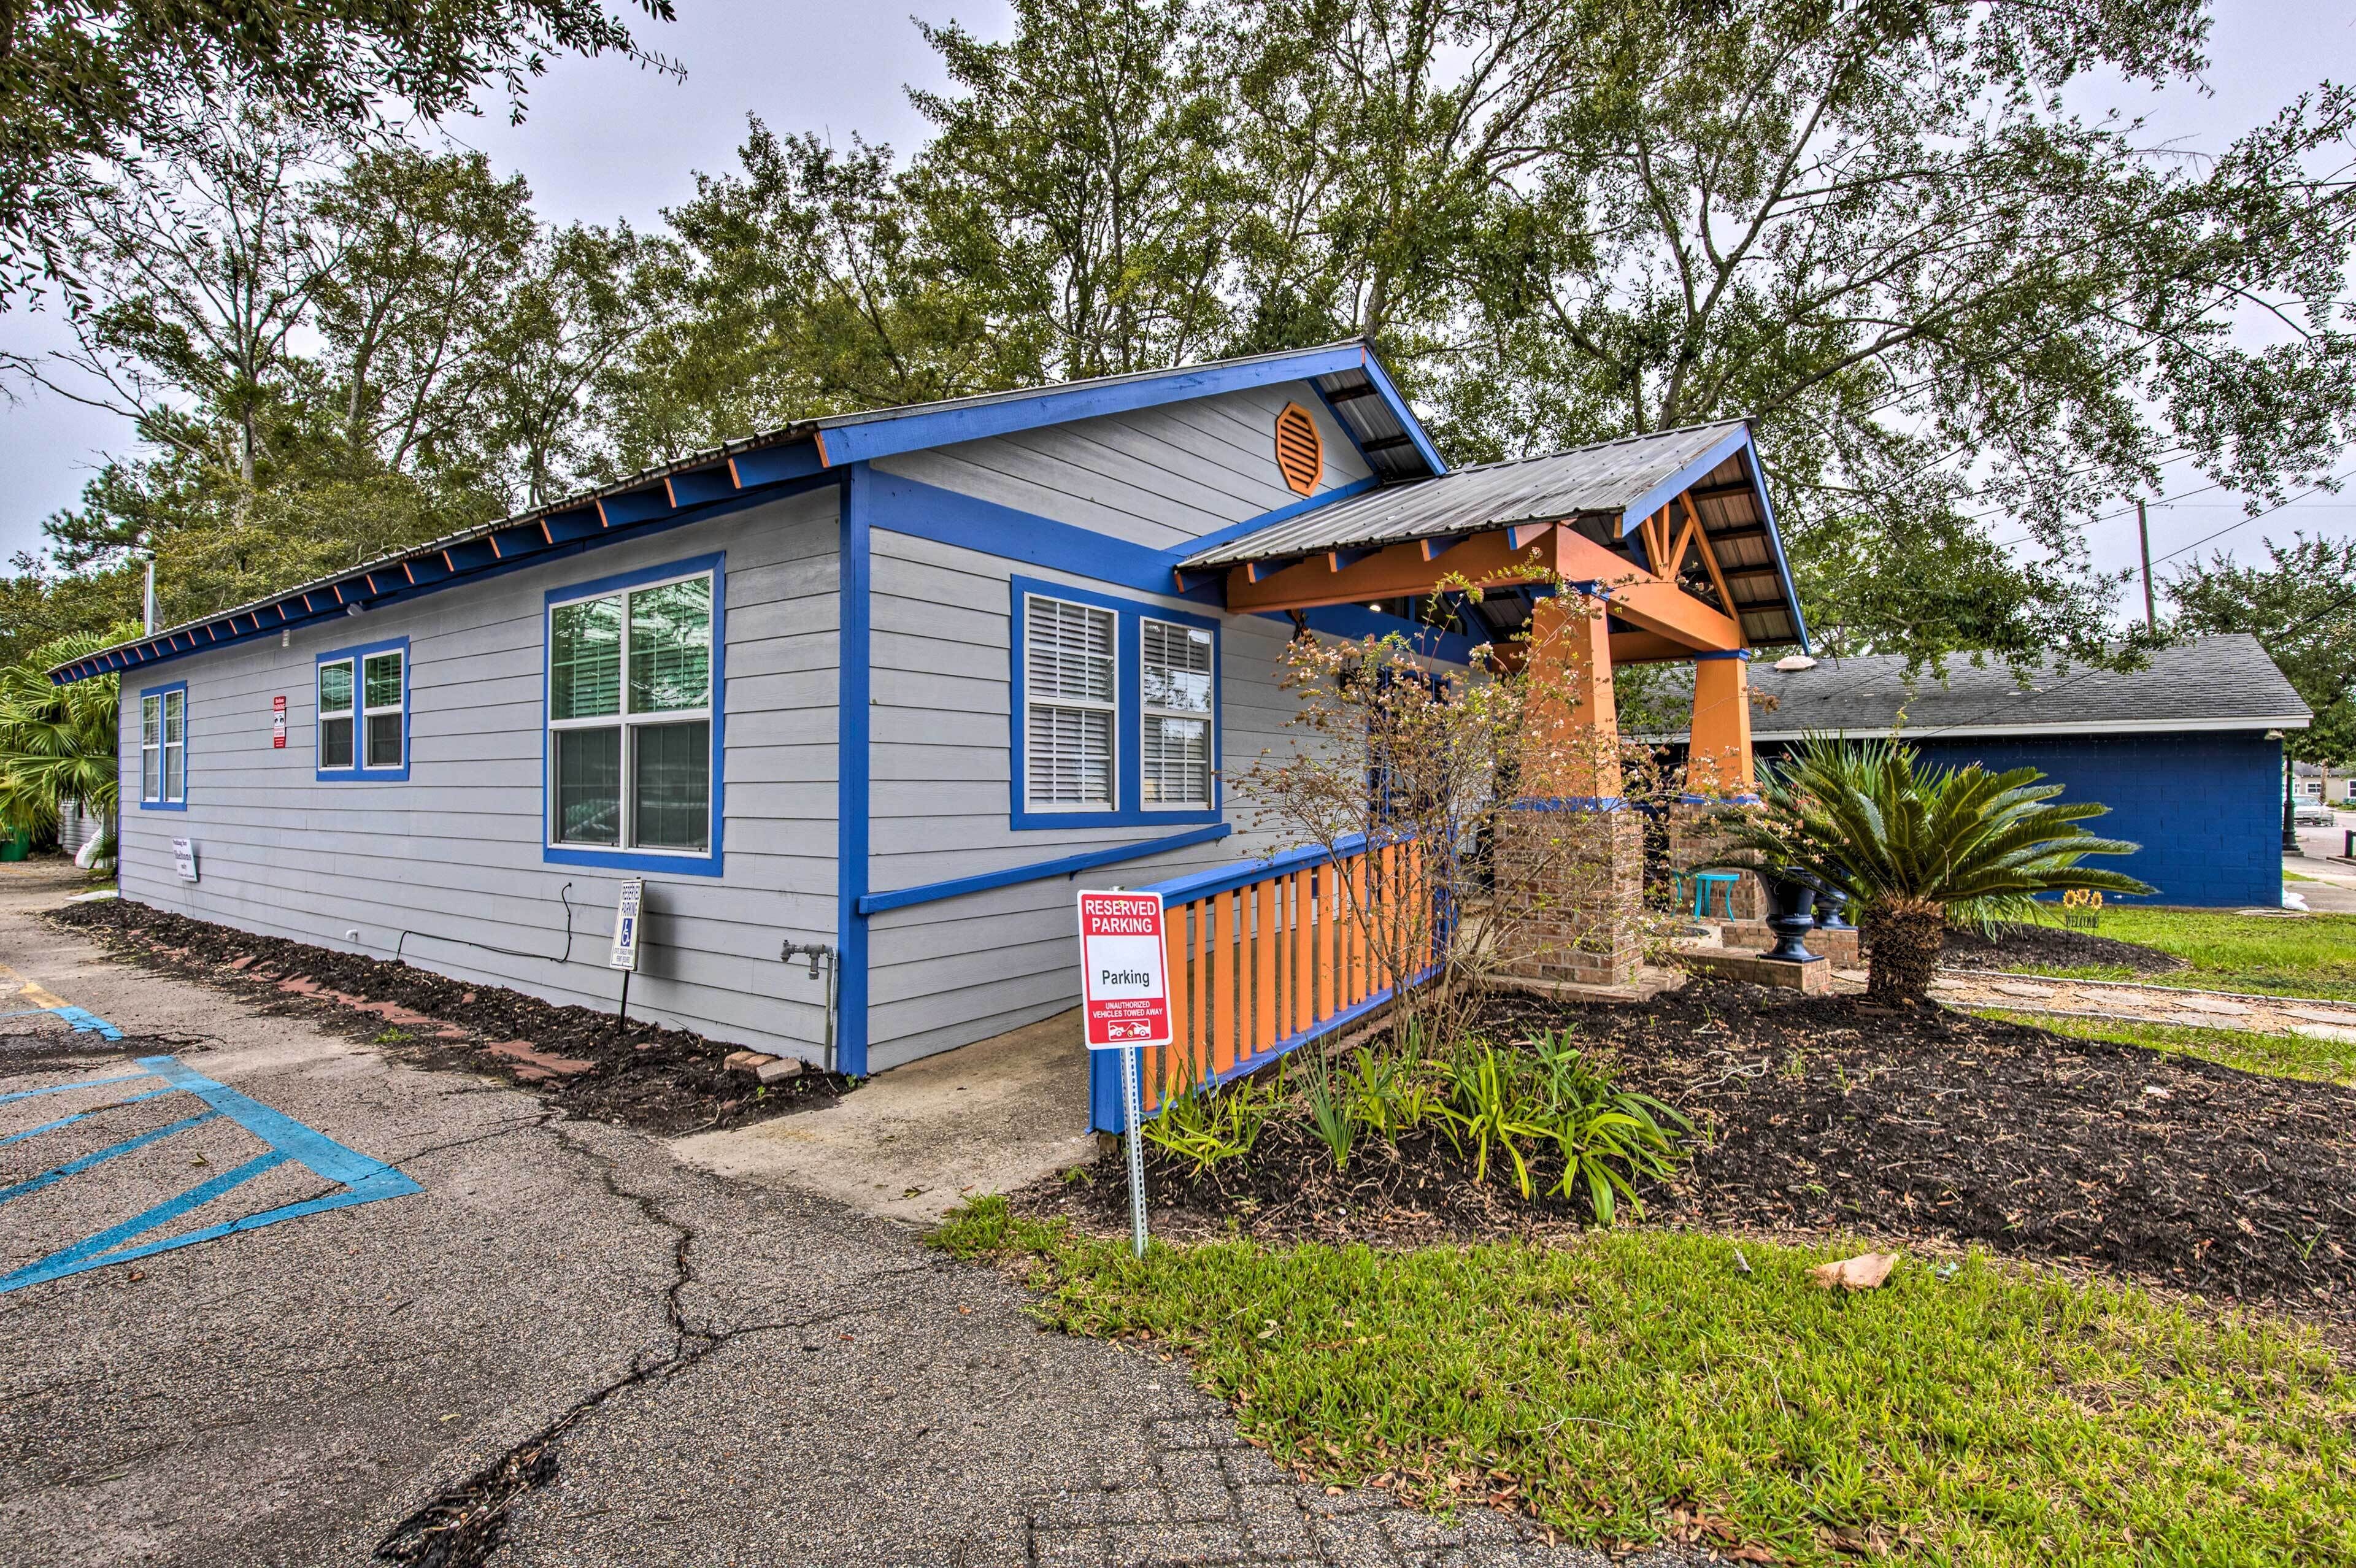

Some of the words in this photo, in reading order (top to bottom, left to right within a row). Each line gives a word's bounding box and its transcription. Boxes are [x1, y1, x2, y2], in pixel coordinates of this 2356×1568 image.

[623, 885, 640, 900] RESERVED
[622, 902, 637, 917] PARKING
[1085, 899, 1157, 917] RESERVED
[1092, 918, 1153, 933] PARKING
[2066, 915, 2099, 928] WELCOME
[1102, 969, 1149, 988] Parking
[1093, 1010, 1123, 1018] VEHICLES
[1145, 1008, 1163, 1017] AWAY
[1106, 1001, 1150, 1010] UNAUTHORIZED
